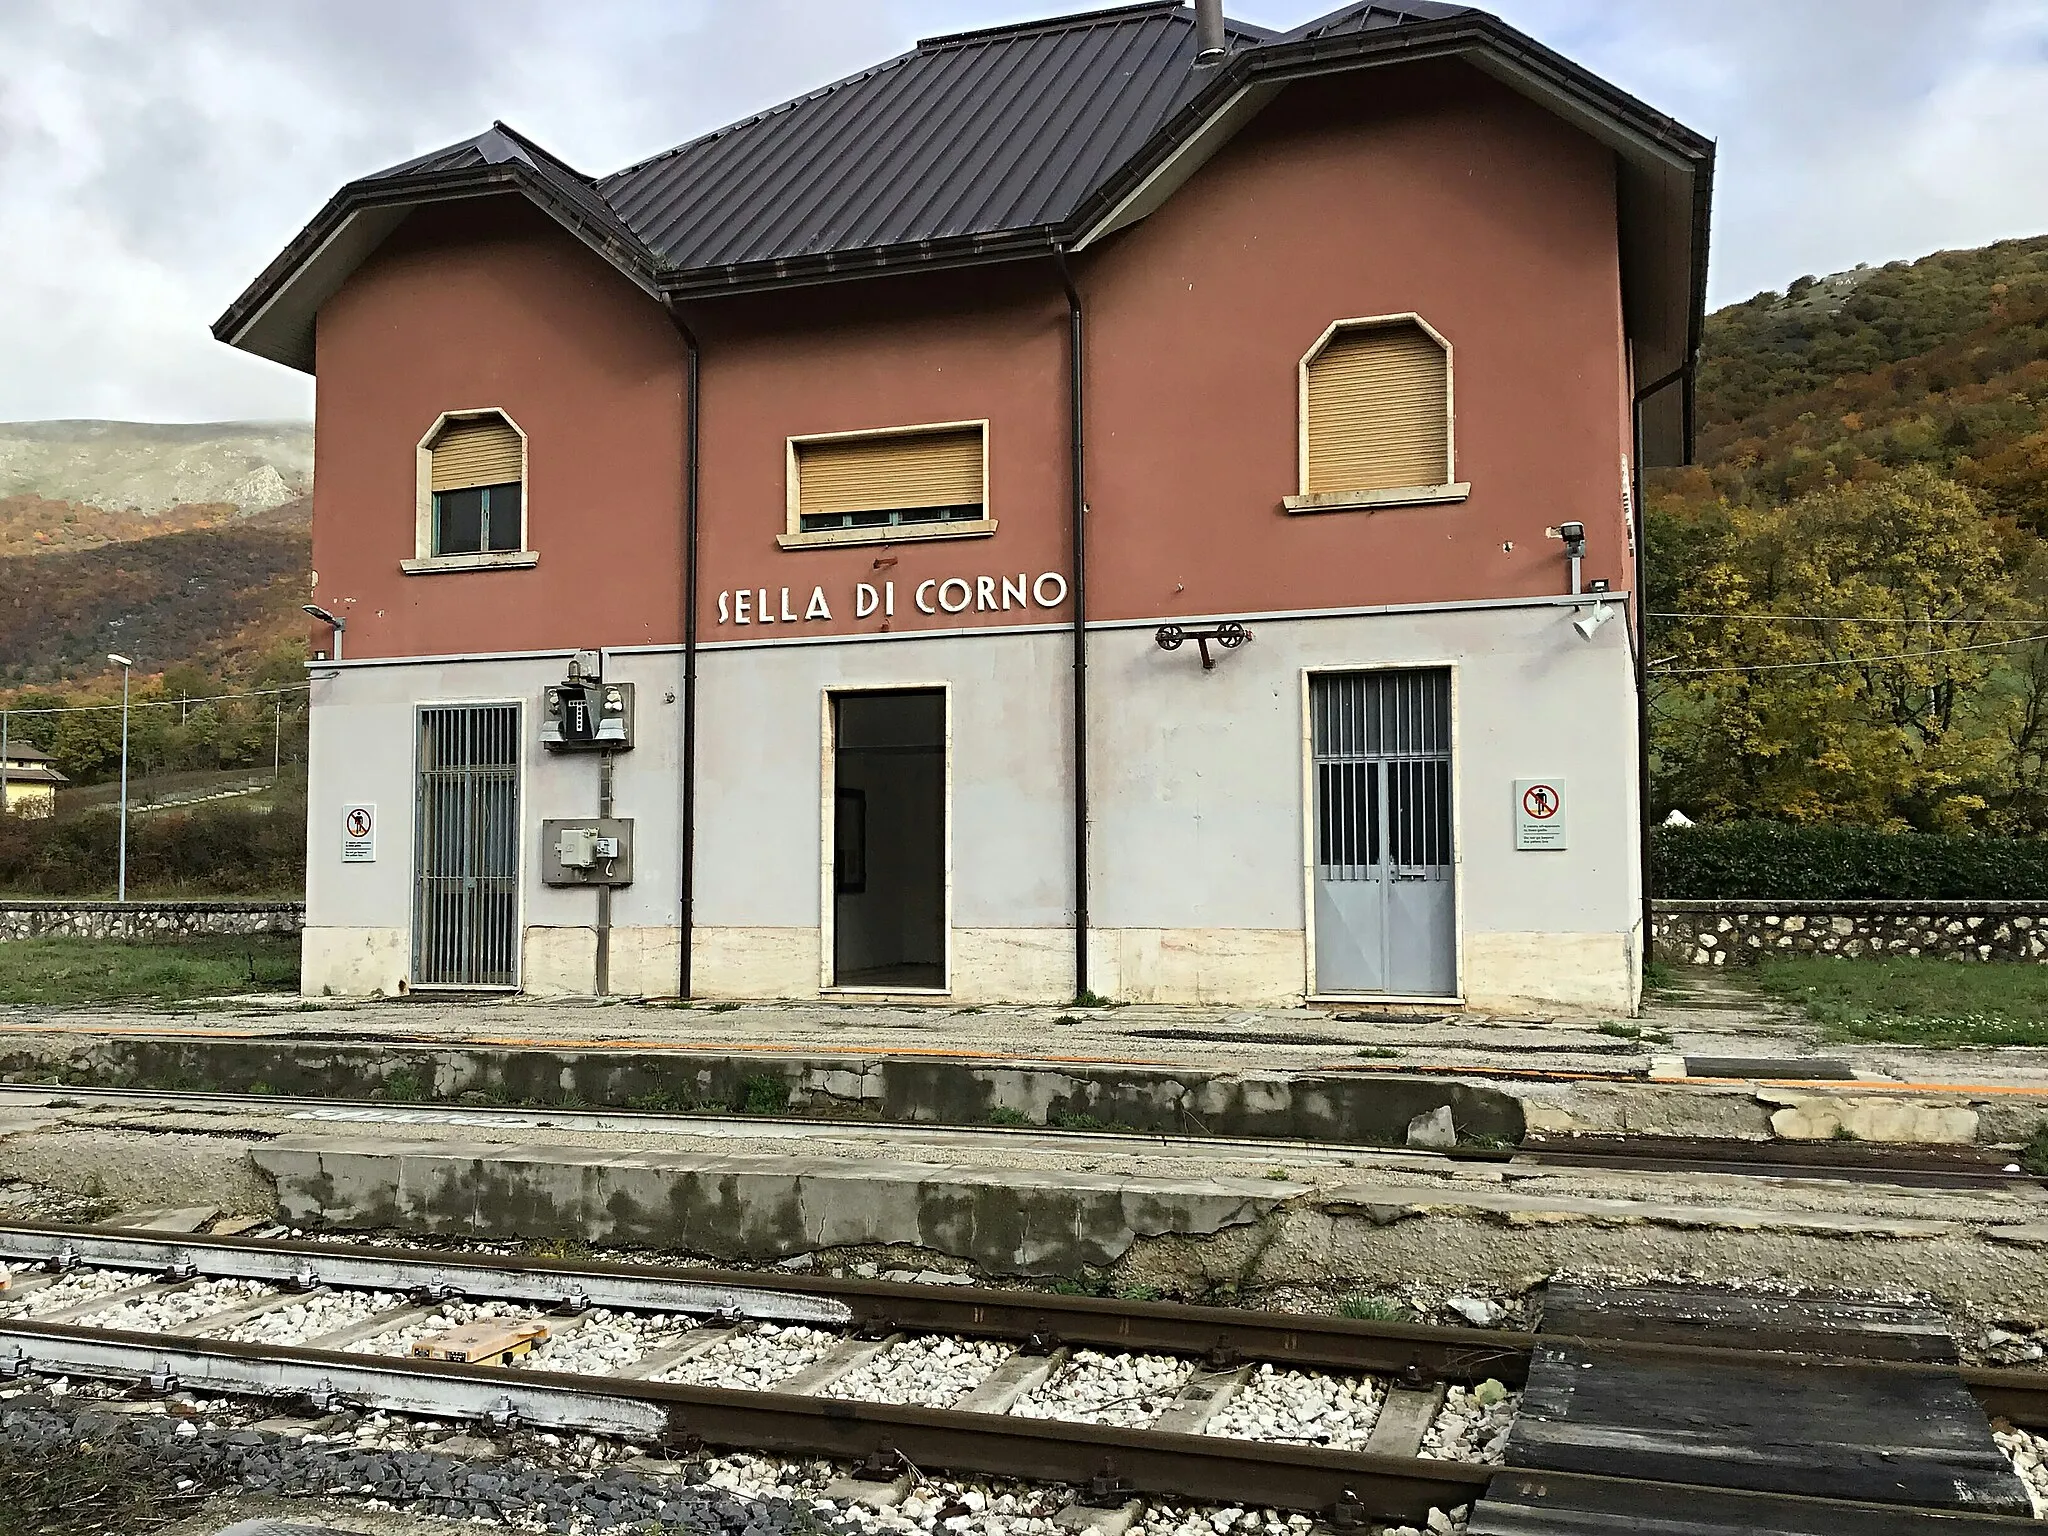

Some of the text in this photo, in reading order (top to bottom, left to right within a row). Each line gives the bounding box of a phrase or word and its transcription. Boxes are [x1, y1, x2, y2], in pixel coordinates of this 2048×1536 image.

[717, 571, 1069, 625] SELLA DI CORNO
[568, 699, 587, 732] T
